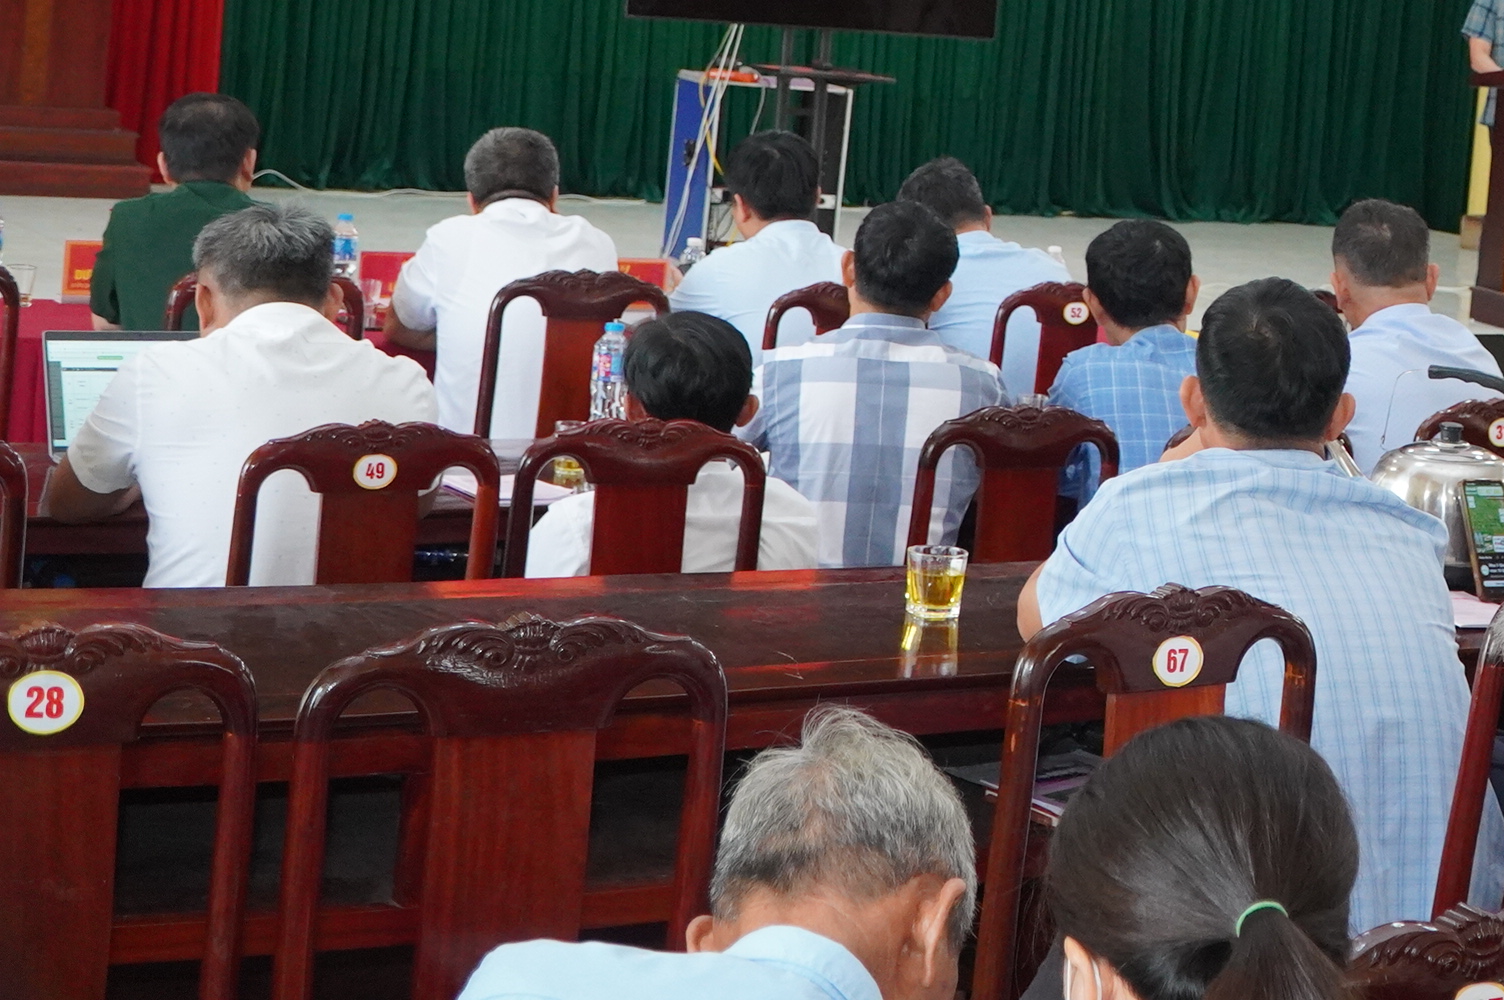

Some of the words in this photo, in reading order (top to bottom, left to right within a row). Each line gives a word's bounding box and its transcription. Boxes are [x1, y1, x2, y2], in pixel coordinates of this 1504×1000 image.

[1071, 307, 1082, 318] 52
[365, 464, 385, 479] 49
[1167, 648, 1189, 673] 67
[25, 686, 64, 719] 28
